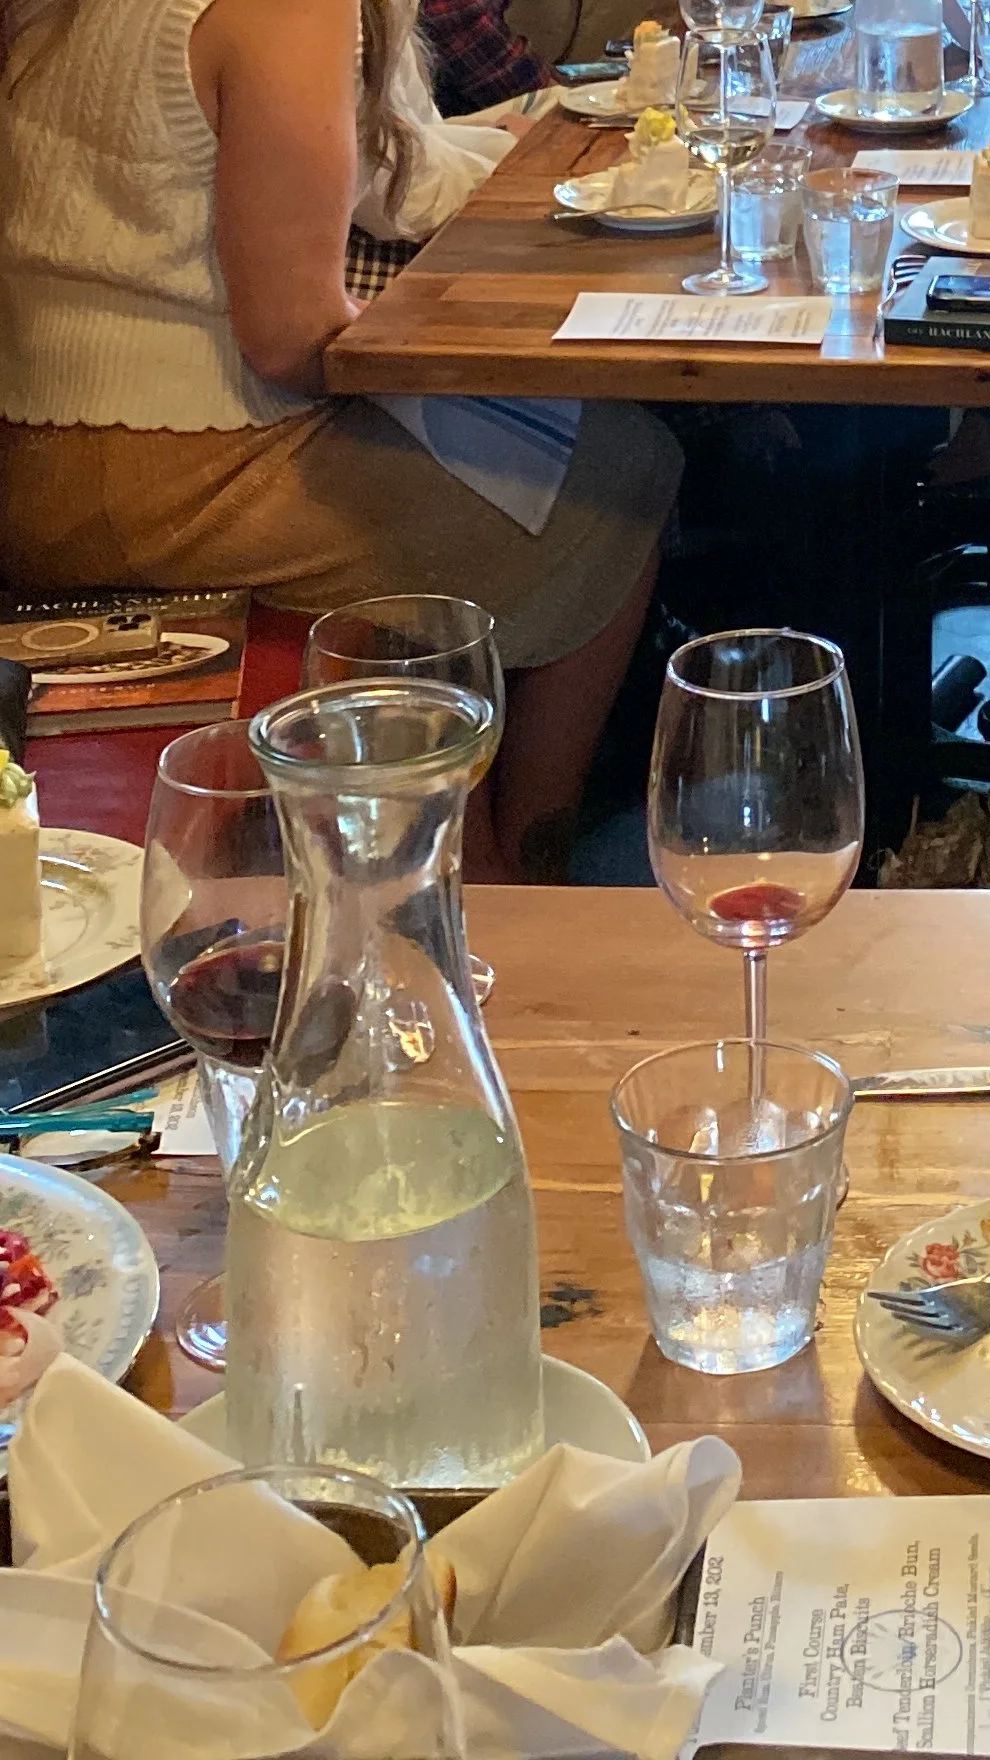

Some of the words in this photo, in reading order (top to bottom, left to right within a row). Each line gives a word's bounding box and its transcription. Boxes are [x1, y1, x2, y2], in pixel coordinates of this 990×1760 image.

[901, 1540, 920, 1577] Bun,
[923, 1547, 941, 1598] Cream
[743, 1596, 765, 1644] Punch
[803, 1608, 823, 1658] Course
[850, 1597, 871, 1657] Biscuits
[898, 1581, 917, 1640] Brioche
[826, 1624, 845, 1660] Ham
[919, 1601, 939, 1691] Horseradish
[734, 1648, 759, 1710] Planter's
[798, 1661, 817, 1698] First
[820, 1664, 846, 1722] Country
[845, 1659, 866, 1709] Beaten
[892, 1726, 909, 1752] eef
[915, 1694, 935, 1749] Scallion
